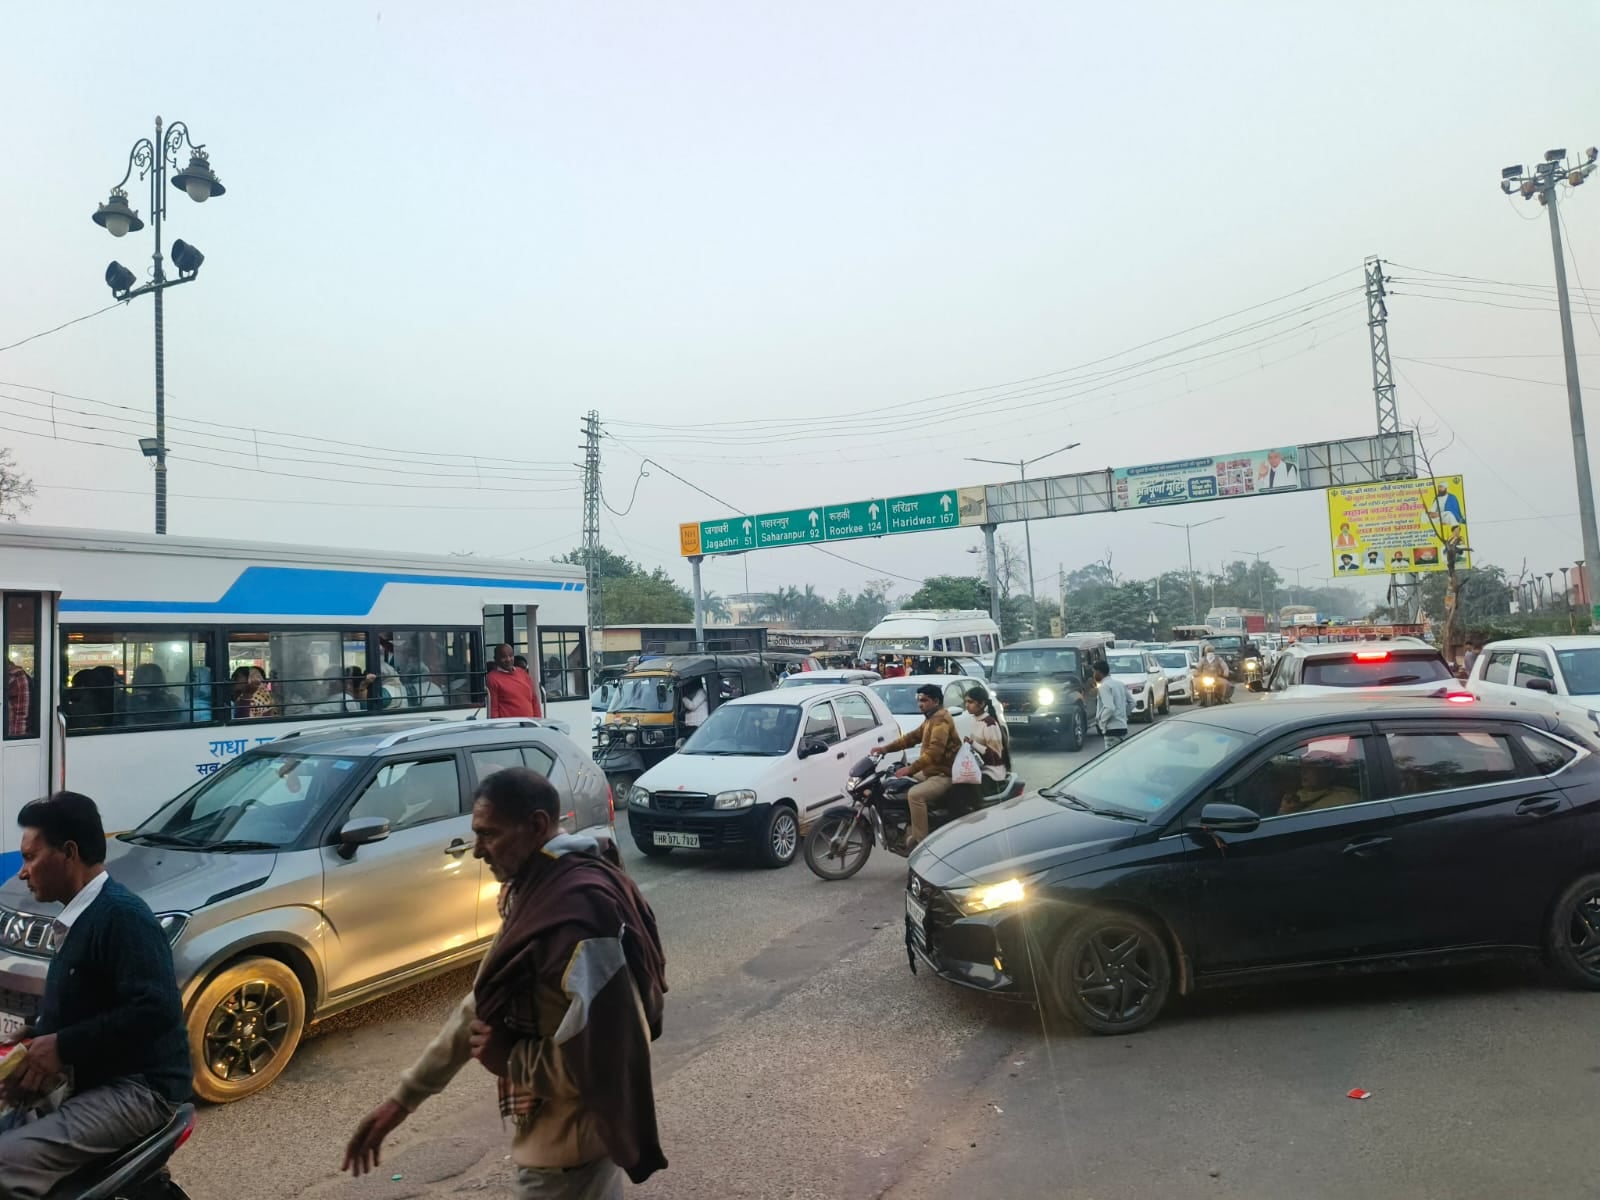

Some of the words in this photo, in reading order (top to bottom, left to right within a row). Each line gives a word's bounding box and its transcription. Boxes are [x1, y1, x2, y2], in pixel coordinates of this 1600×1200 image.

[892, 514, 936, 528] Haridwar
[940, 513, 954, 524] 167
[761, 530, 806, 543] Saharanpur
[809, 528, 820, 538] 92
[829, 524, 863, 536] Roorkee
[868, 521, 882, 532] 124
[705, 536, 739, 550] Jagadhri
[744, 536, 752, 546] 51
[208, 739, 249, 757] राधा
